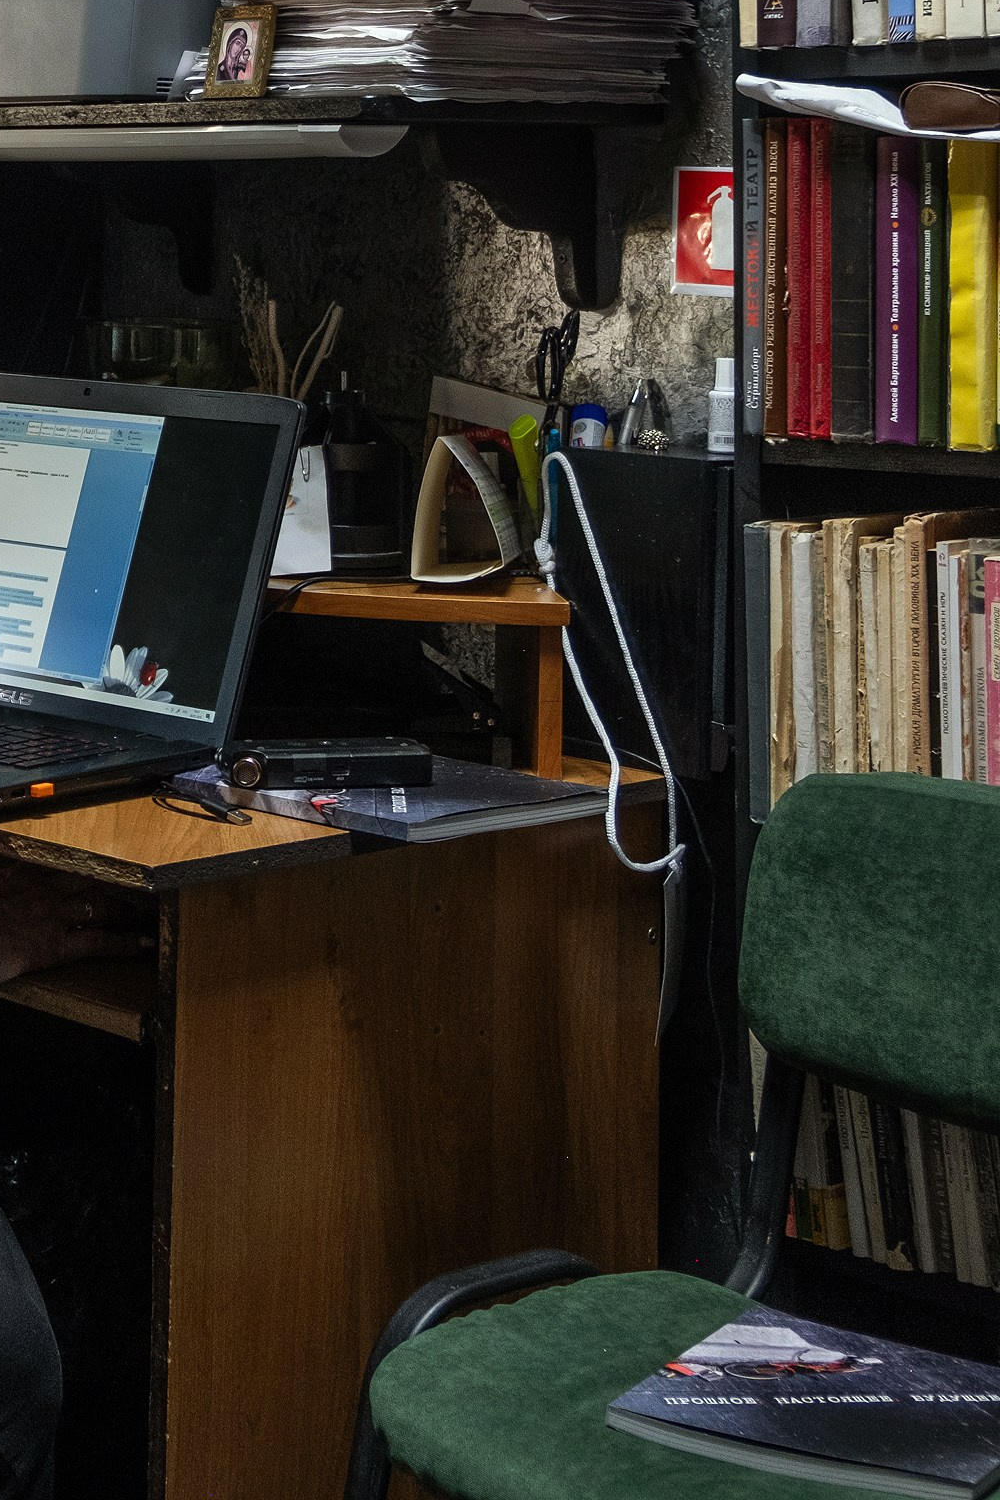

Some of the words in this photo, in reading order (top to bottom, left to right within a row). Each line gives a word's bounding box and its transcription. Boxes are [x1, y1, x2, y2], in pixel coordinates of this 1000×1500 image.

[746, 148, 759, 211] ТЕАТР
[769, 140, 779, 173] ПЬЕСЫ
[891, 151, 899, 172] века
[768, 176, 778, 216] АНАЛИЗ
[890, 188, 899, 219] Начало
[745, 220, 760, 329] ЖЕСТОКИЙ
[767, 216, 777, 288] ДЕЙСТВЕННЫЙ
[891, 231, 900, 267] хроники
[766, 293, 776, 347] РЕЖИССЕРА
[890, 267, 899, 324] Театральные
[750, 346, 762, 409] Стриндберг
[765, 349, 775, 409] МАСТЕРСТВО
[890, 333, 899, 386] Бартошевич
[890, 387, 899, 423] Алексей
[911, 581, 921, 625] ПОЛОВИНЫ
[910, 659, 923, 717] ДРАМАТУРГИЯ
[941, 647, 949, 735] ПСИХОТЕРАПЕВТИЧЕСКИЕ
[977, 666, 985, 718] ПРУТКОВА
[978, 720, 986, 762] КОЗЬМЫ
[773, 1395, 894, 1406] НАСТОЯЩЕЕ
